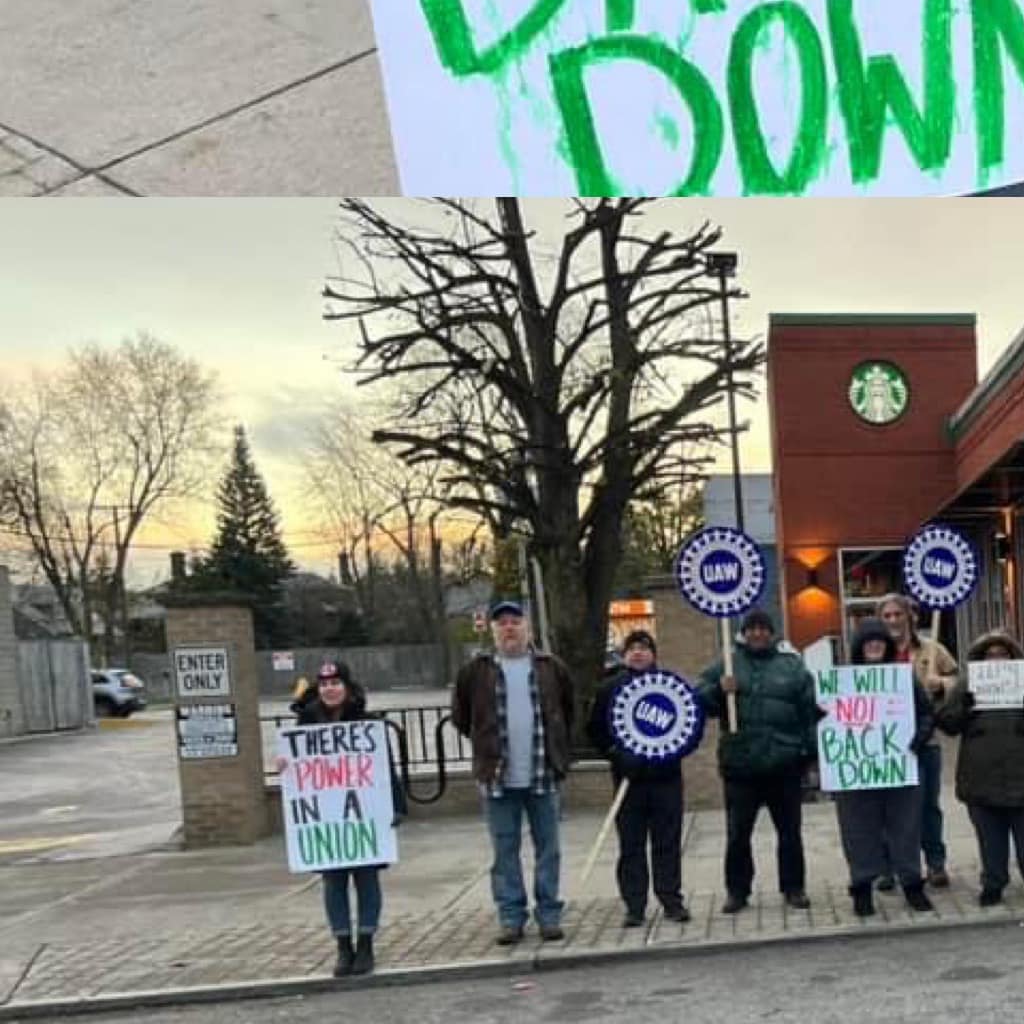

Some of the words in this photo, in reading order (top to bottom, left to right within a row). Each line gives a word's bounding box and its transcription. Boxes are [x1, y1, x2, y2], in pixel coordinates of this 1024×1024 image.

[702, 561, 742, 584] UAW
[178, 653, 225, 671] ENTER
[184, 673, 222, 690] ONLY
[854, 667, 902, 693] WILL
[635, 701, 675, 729] UAW
[836, 697, 877, 722] NOT
[822, 722, 902, 764] BACK
[294, 755, 374, 791] POWER
[838, 754, 906, 788] DOWN
[291, 794, 321, 824] IN
[343, 789, 363, 820] A
[298, 821, 378, 866] UNION
